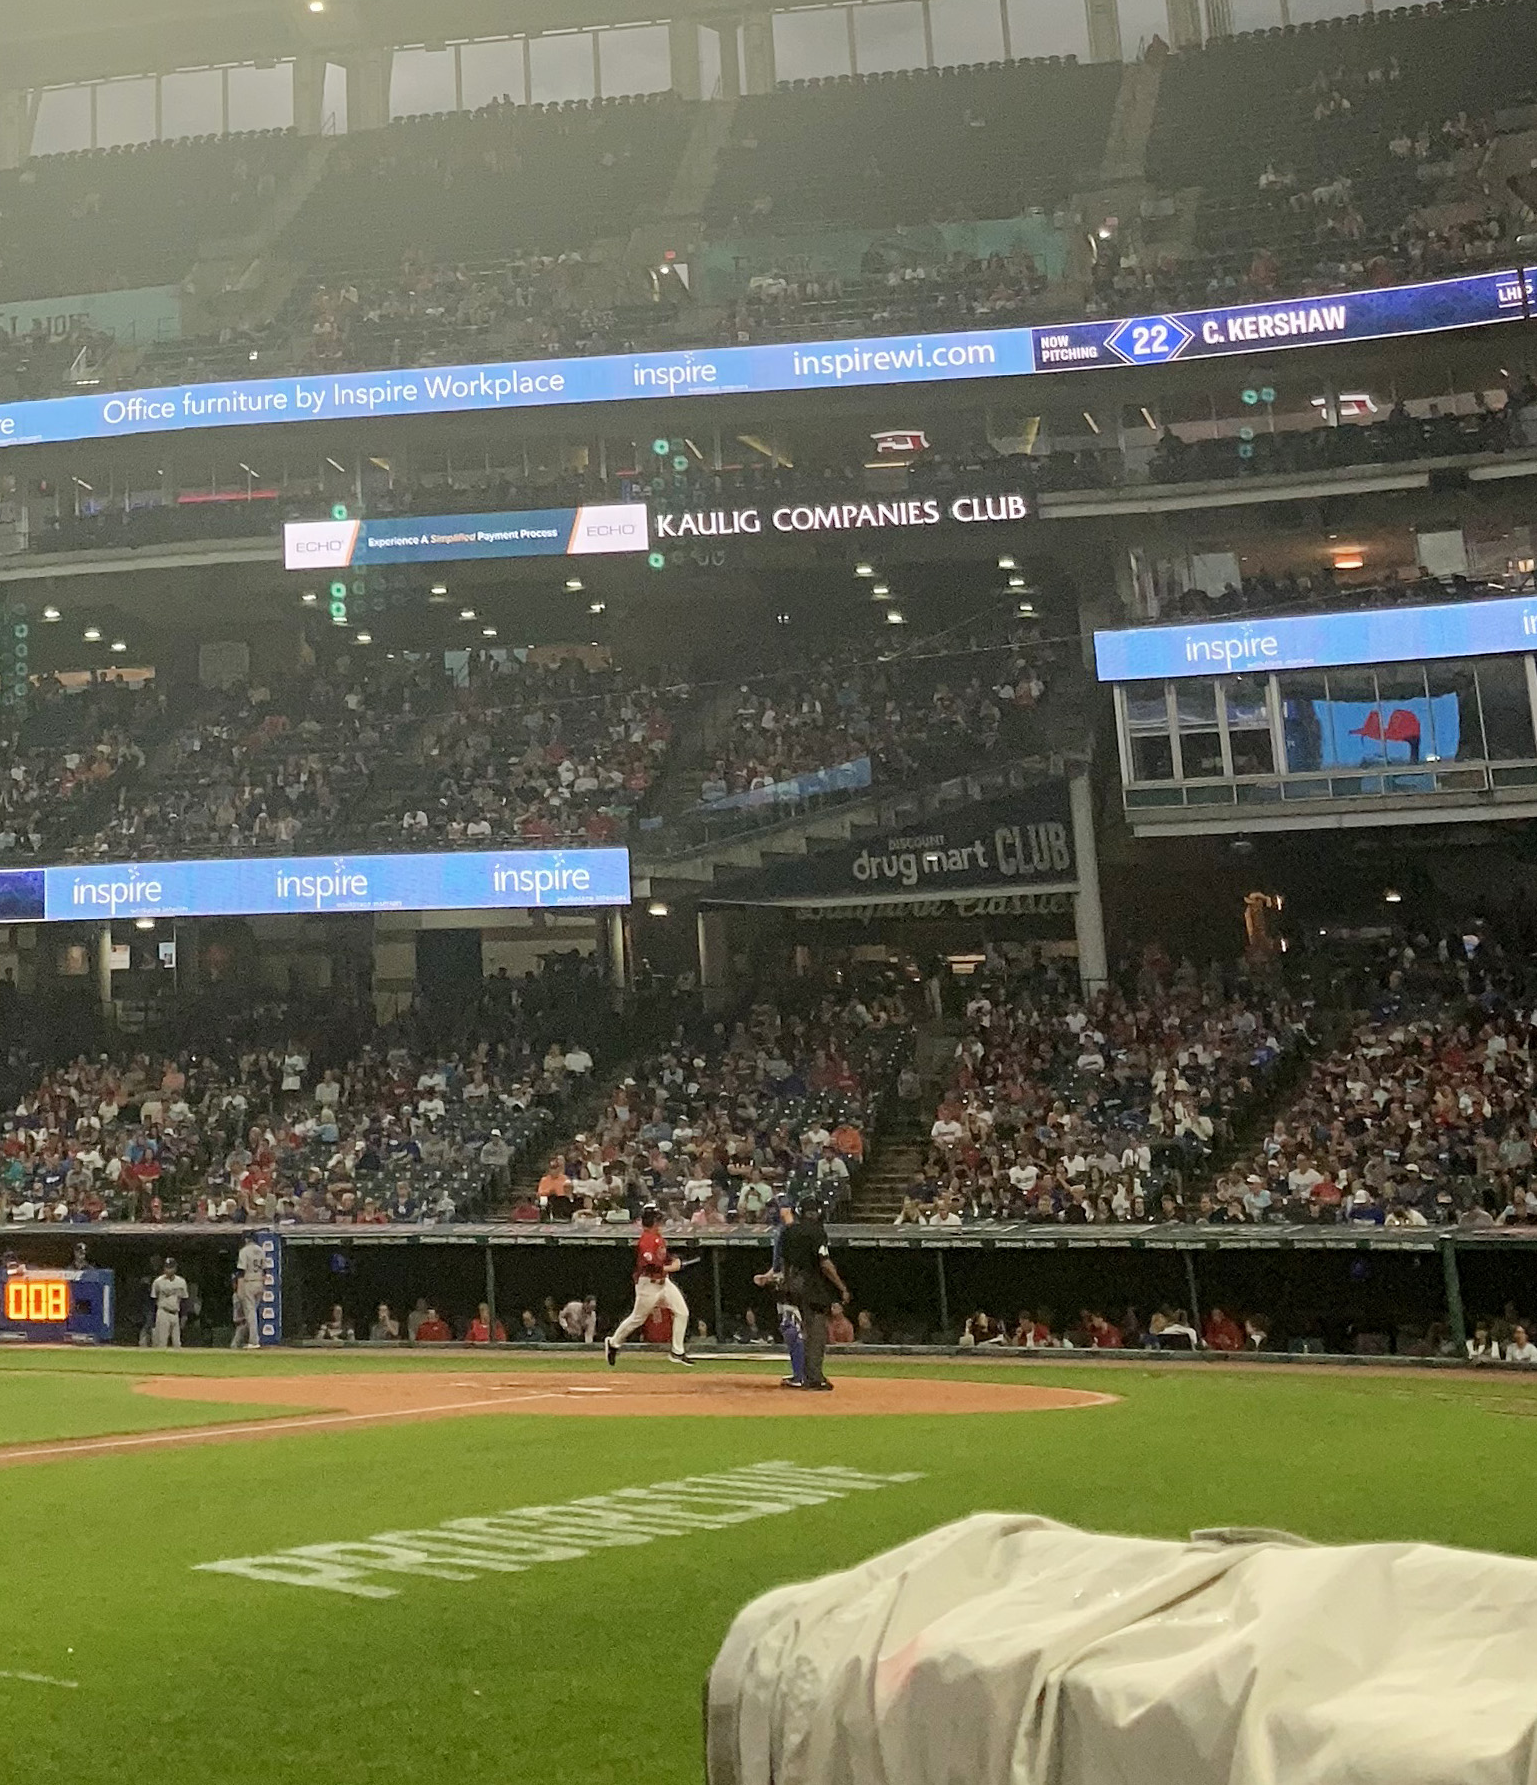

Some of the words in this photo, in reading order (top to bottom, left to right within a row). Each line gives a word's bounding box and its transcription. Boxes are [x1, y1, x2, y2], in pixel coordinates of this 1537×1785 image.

[1040, 335, 1070, 349] NOW
[1131, 326, 1170, 355] 22
[1227, 304, 1347, 342] KERSHAW
[1041, 345, 1098, 362] PITCHING
[102, 398, 176, 425] Office
[182, 390, 288, 418] furniture
[295, 385, 326, 413] by
[332, 380, 419, 411] Inspire
[423, 370, 566, 401] Workplace
[632, 360, 718, 394] inspire
[792, 337, 996, 378] inspirewi.com
[656, 511, 761, 539] KAULIG
[772, 500, 940, 533] COMPANIES
[952, 495, 1026, 523] CLUB
[295, 539, 343, 555] ECHO
[367, 534, 420, 549] Experience
[477, 529, 518, 544] Payment
[519, 527, 558, 541] Process
[585, 524, 636, 539] ECHO
[1185, 634, 1279, 671] inspire
[853, 849, 919, 886] drug
[922, 839, 990, 874] mart
[994, 821, 1071, 876] CLUB
[72, 874, 163, 915] inspire
[276, 869, 369, 910] inspire
[493, 862, 591, 904] inspire
[7, 1281, 68, 1321] 008
